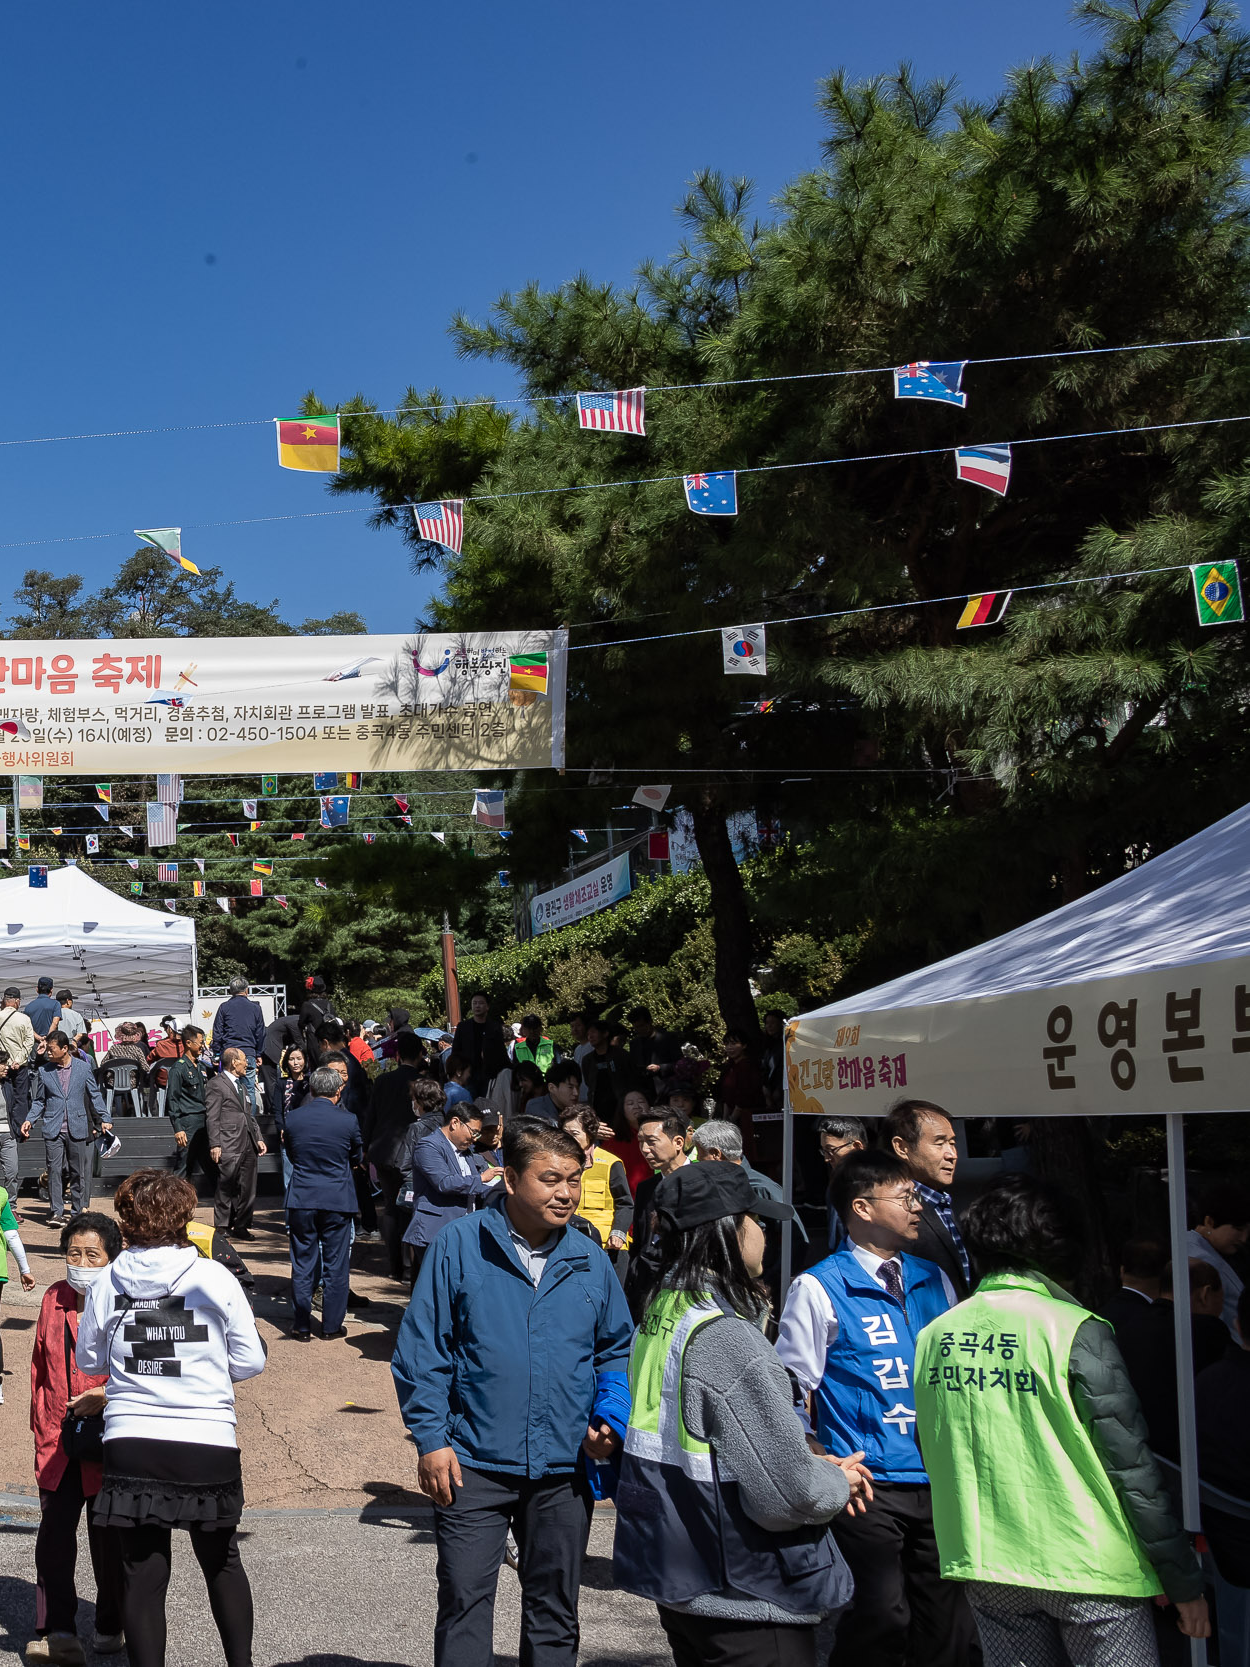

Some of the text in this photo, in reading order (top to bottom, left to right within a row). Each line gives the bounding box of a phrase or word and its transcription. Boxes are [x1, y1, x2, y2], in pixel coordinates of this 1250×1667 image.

[91, 652, 162, 694] 축제
[455, 656, 507, 676] 행복광진
[48, 707, 110, 724] 체험부스,
[114, 706, 162, 723] 먹거리,
[167, 705, 229, 723] 경품추첨,
[233, 705, 292, 721] 자치회관
[296, 703, 356, 720] 프로그램
[360, 703, 394, 720] 발표,
[398, 702, 459, 719] 초대가수
[462, 701, 492, 718] 공연
[78, 726, 153, 744] 16시(예정)
[165, 726, 193, 743] 문의
[207, 725, 318, 742] 02-450-1504
[322, 725, 350, 741] 또는
[356, 724, 411, 741] 중곡4동
[416, 723, 475, 739] 주민센터
[480, 722, 506, 738] 2층
[834, 1024, 861, 1048] 제9회
[799, 1053, 908, 1091] 긴고랑 한마음 축제
[145, 1325, 186, 1341] WHAT YOU
[939, 1332, 1019, 1360] 중곡4동
[137, 1360, 164, 1375] DESIRE
[861, 1313, 916, 1435] 김갑수
[928, 1365, 1038, 1397] 주민자치회
